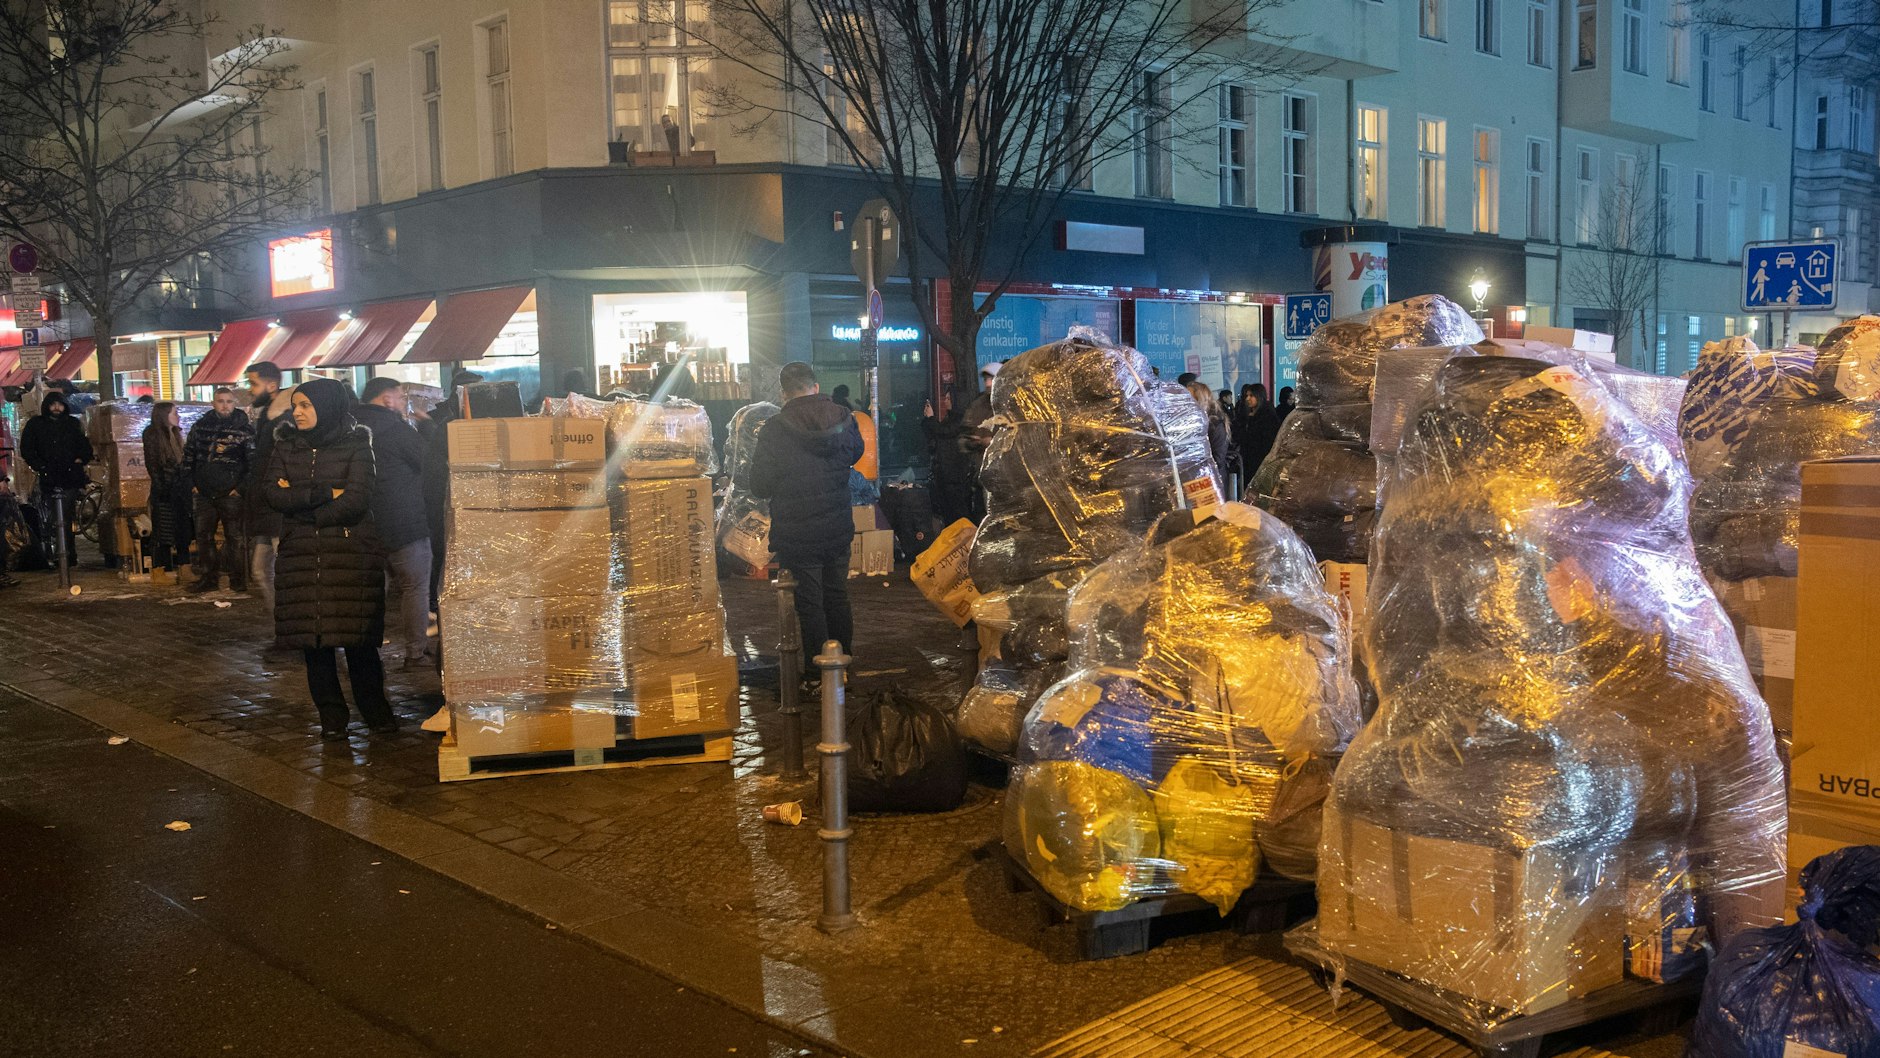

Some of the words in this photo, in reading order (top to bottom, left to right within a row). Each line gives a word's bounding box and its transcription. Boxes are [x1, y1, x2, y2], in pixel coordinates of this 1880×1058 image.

[980, 315, 1014, 332] ünstig
[982, 333, 1029, 347] einkaufen
[1147, 333, 1170, 345] REWE
[1171, 334, 1186, 348] App
[1168, 349, 1182, 360] und
